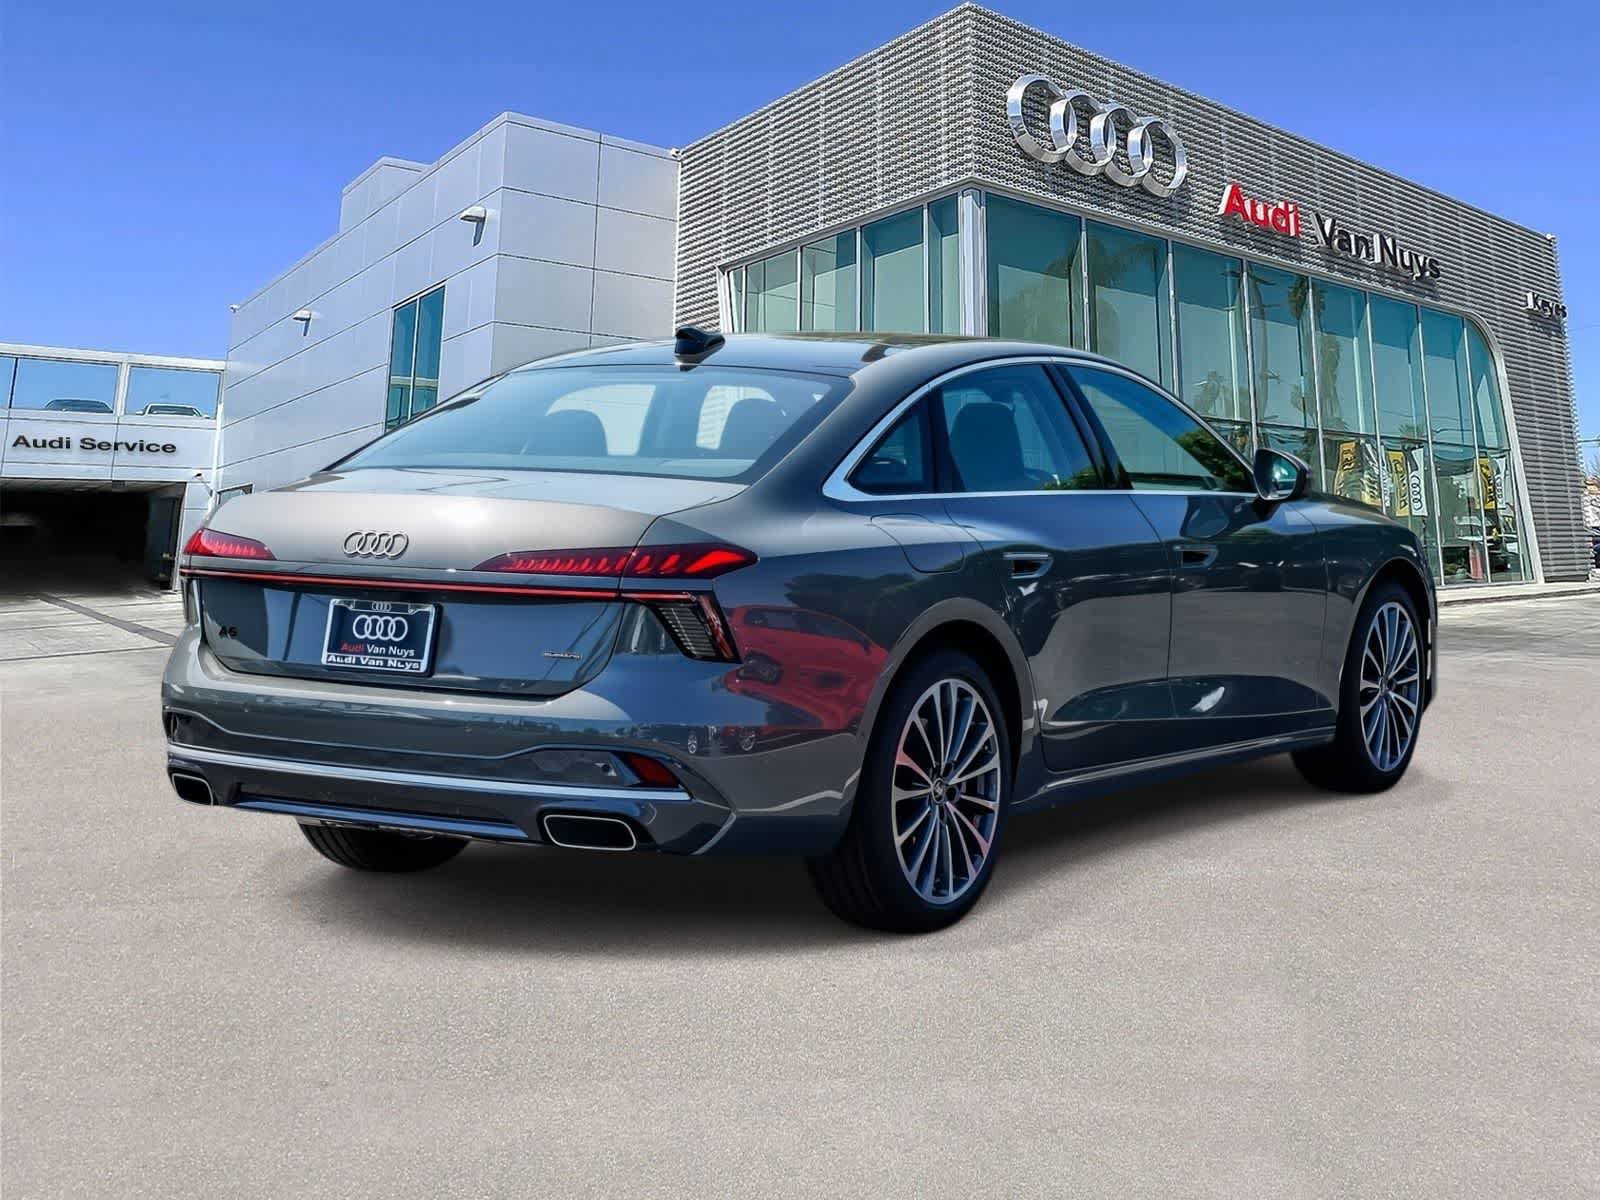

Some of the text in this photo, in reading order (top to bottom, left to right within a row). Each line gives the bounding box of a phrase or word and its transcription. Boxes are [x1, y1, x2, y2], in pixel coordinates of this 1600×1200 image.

[1217, 182, 1440, 280] Audi Van Nuys
[12, 435, 177, 453] Audi Service
[340, 642, 415, 658] Audi Van Nuys
[327, 654, 356, 665] Audi
[360, 656, 383, 667] Van
